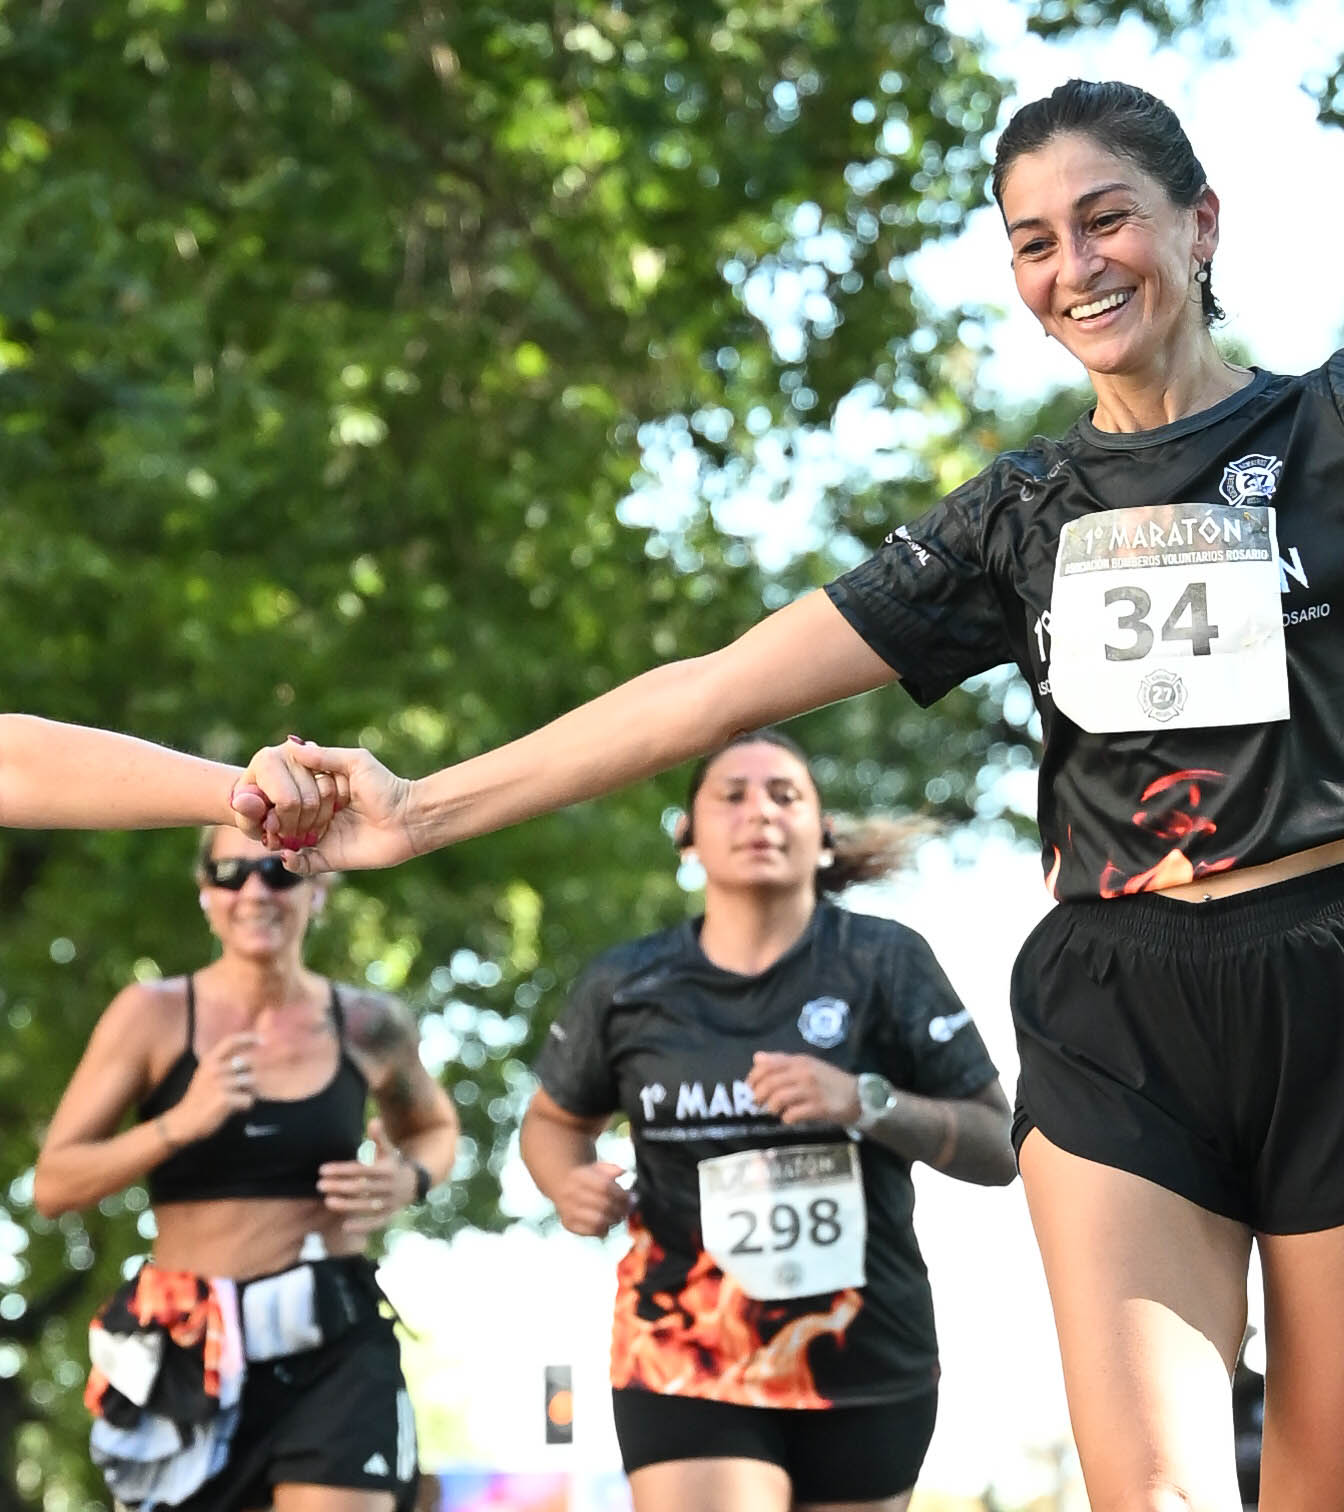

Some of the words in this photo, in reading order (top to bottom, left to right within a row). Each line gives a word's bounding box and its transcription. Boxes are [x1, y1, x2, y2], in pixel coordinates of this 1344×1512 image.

[1108, 510, 1242, 551] MARATÓN
[1162, 549, 1224, 566] VOLUNTARIOS
[1225, 548, 1269, 562] ROSARIO
[1103, 582, 1219, 662] 34
[1281, 603, 1331, 628] OSARIO
[727, 1198, 842, 1256] 298
